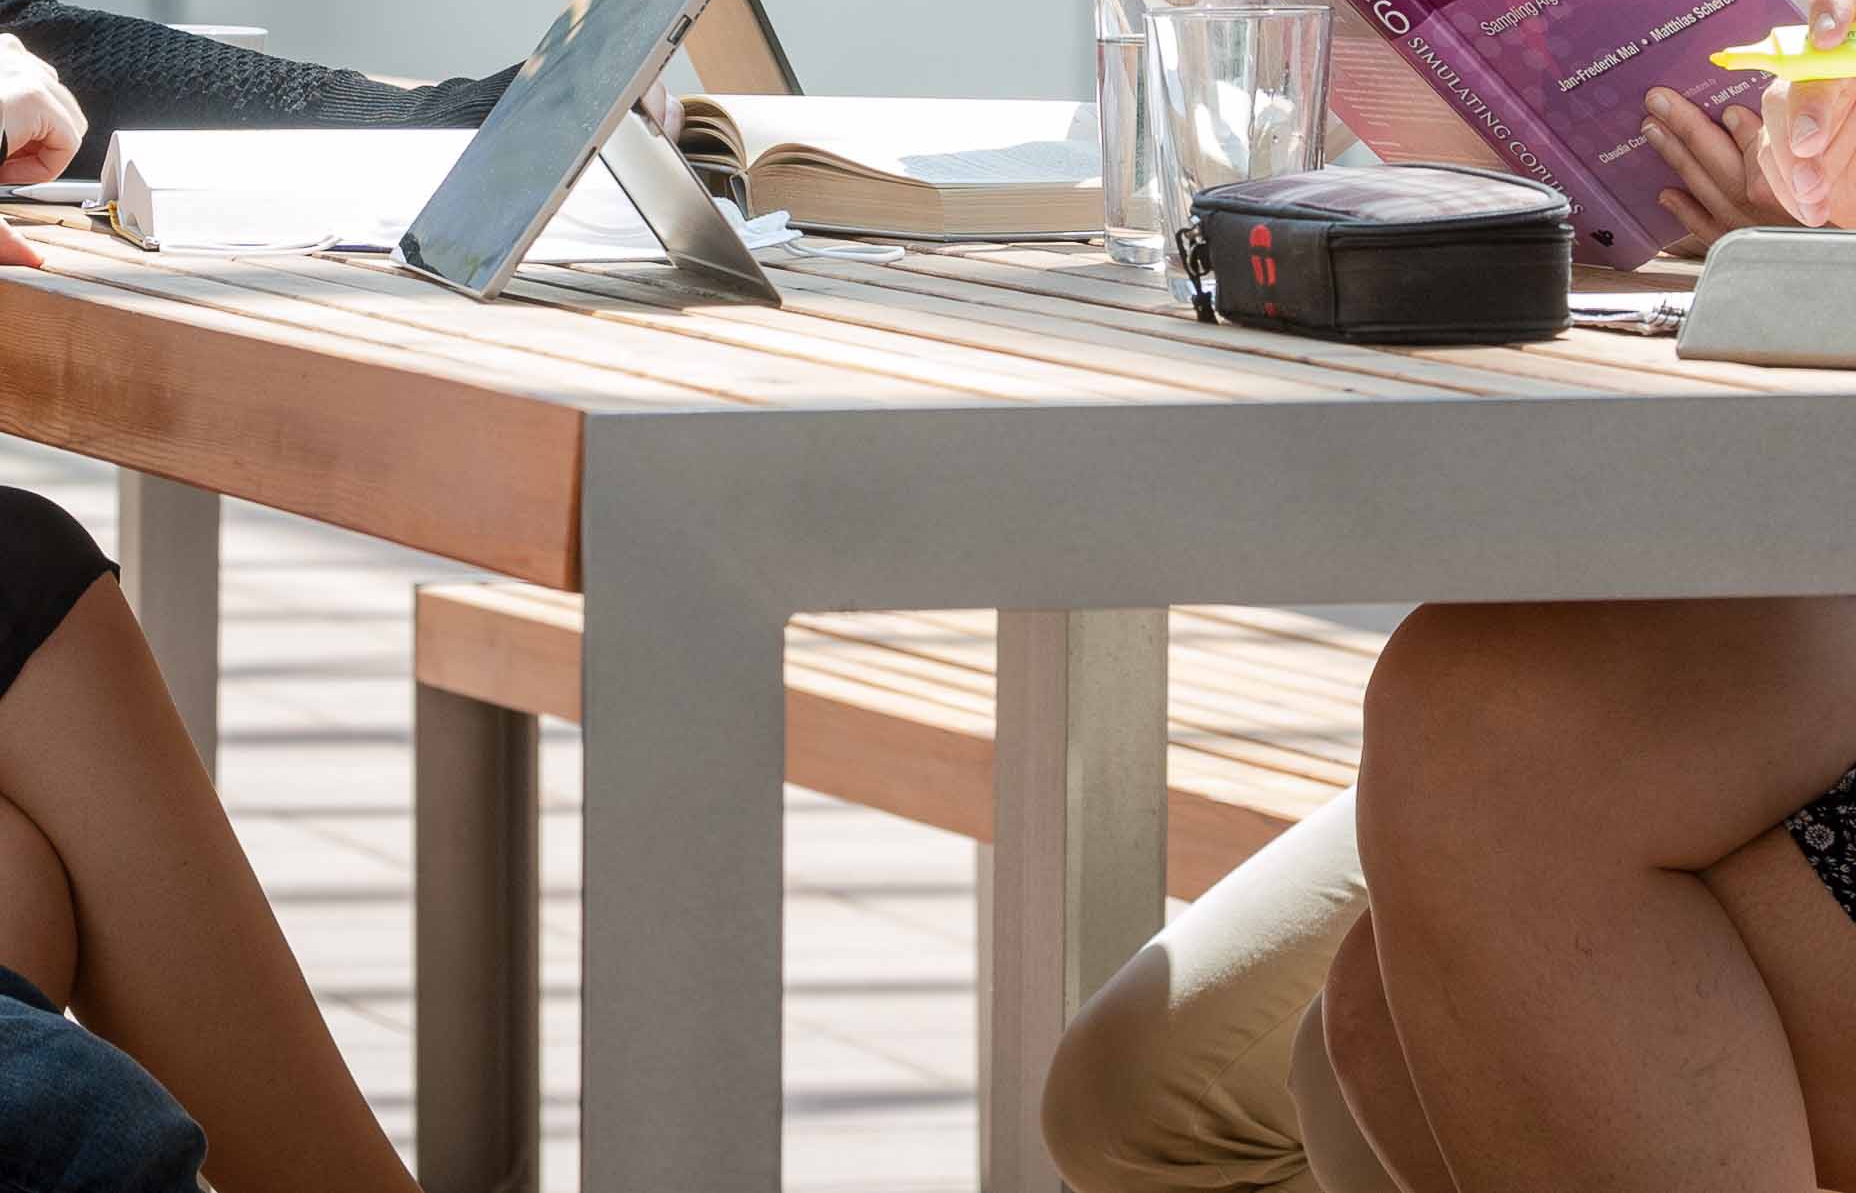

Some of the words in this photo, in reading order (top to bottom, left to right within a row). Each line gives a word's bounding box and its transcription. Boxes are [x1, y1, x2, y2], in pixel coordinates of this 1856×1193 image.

[1372, 0, 1410, 35] 6
[1558, 50, 1622, 92] Jan-Frederik
[1649, 11, 1697, 43] Matthias
[1406, 36, 1512, 142] SIMULATING
[1710, 88, 1731, 105] Ralf
[1727, 81, 1750, 97] Korn
[1597, 143, 1632, 165] Claudia
